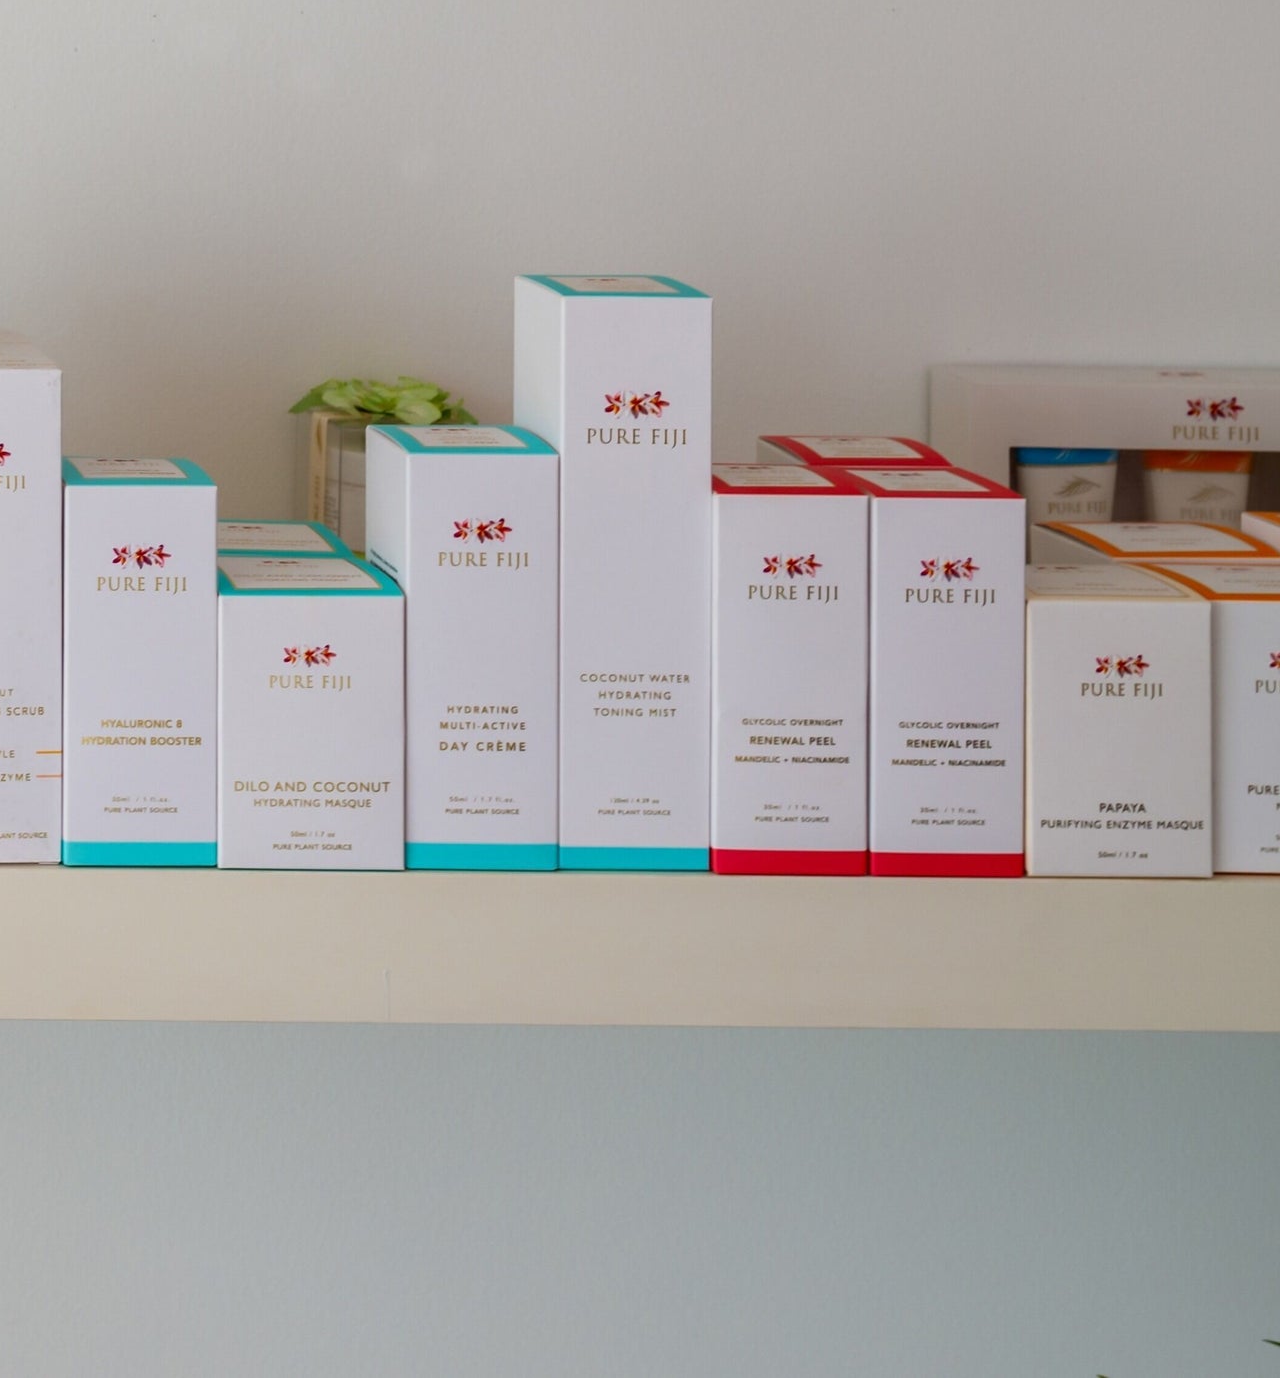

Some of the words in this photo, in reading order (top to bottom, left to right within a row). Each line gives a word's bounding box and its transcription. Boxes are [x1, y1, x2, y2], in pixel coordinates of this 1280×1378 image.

[588, 428, 640, 444] PURE
[652, 429, 686, 448] FIJI
[580, 674, 644, 682] COCONUT
[649, 675, 689, 683] WATER
[1081, 683, 1125, 696] PURE
[1134, 683, 1162, 700] FIJI
[6, 707, 44, 716] SCRUB
[594, 708, 643, 717] TONING
[649, 709, 676, 717] MIST
[101, 720, 172, 728] HYALURONIC
[176, 720, 182, 728] 8
[742, 718, 786, 726] GLYCOLIC
[82, 737, 146, 745] HYDRATION
[150, 737, 202, 745] BOOSTER
[750, 736, 805, 745] RENEWAL
[809, 737, 836, 745] PEEL
[440, 742, 468, 751] DAY
[235, 781, 269, 791] DILO
[274, 782, 307, 792] AND
[313, 782, 390, 792] COCONUT
[254, 799, 320, 807] HYDRATING
[325, 798, 371, 809] MASQUE
[1100, 803, 1146, 812] PAPAYA
[1041, 820, 1102, 829] PURIFYING
[1106, 820, 1152, 829] ENZYME
[1157, 821, 1203, 830] MASQUE
